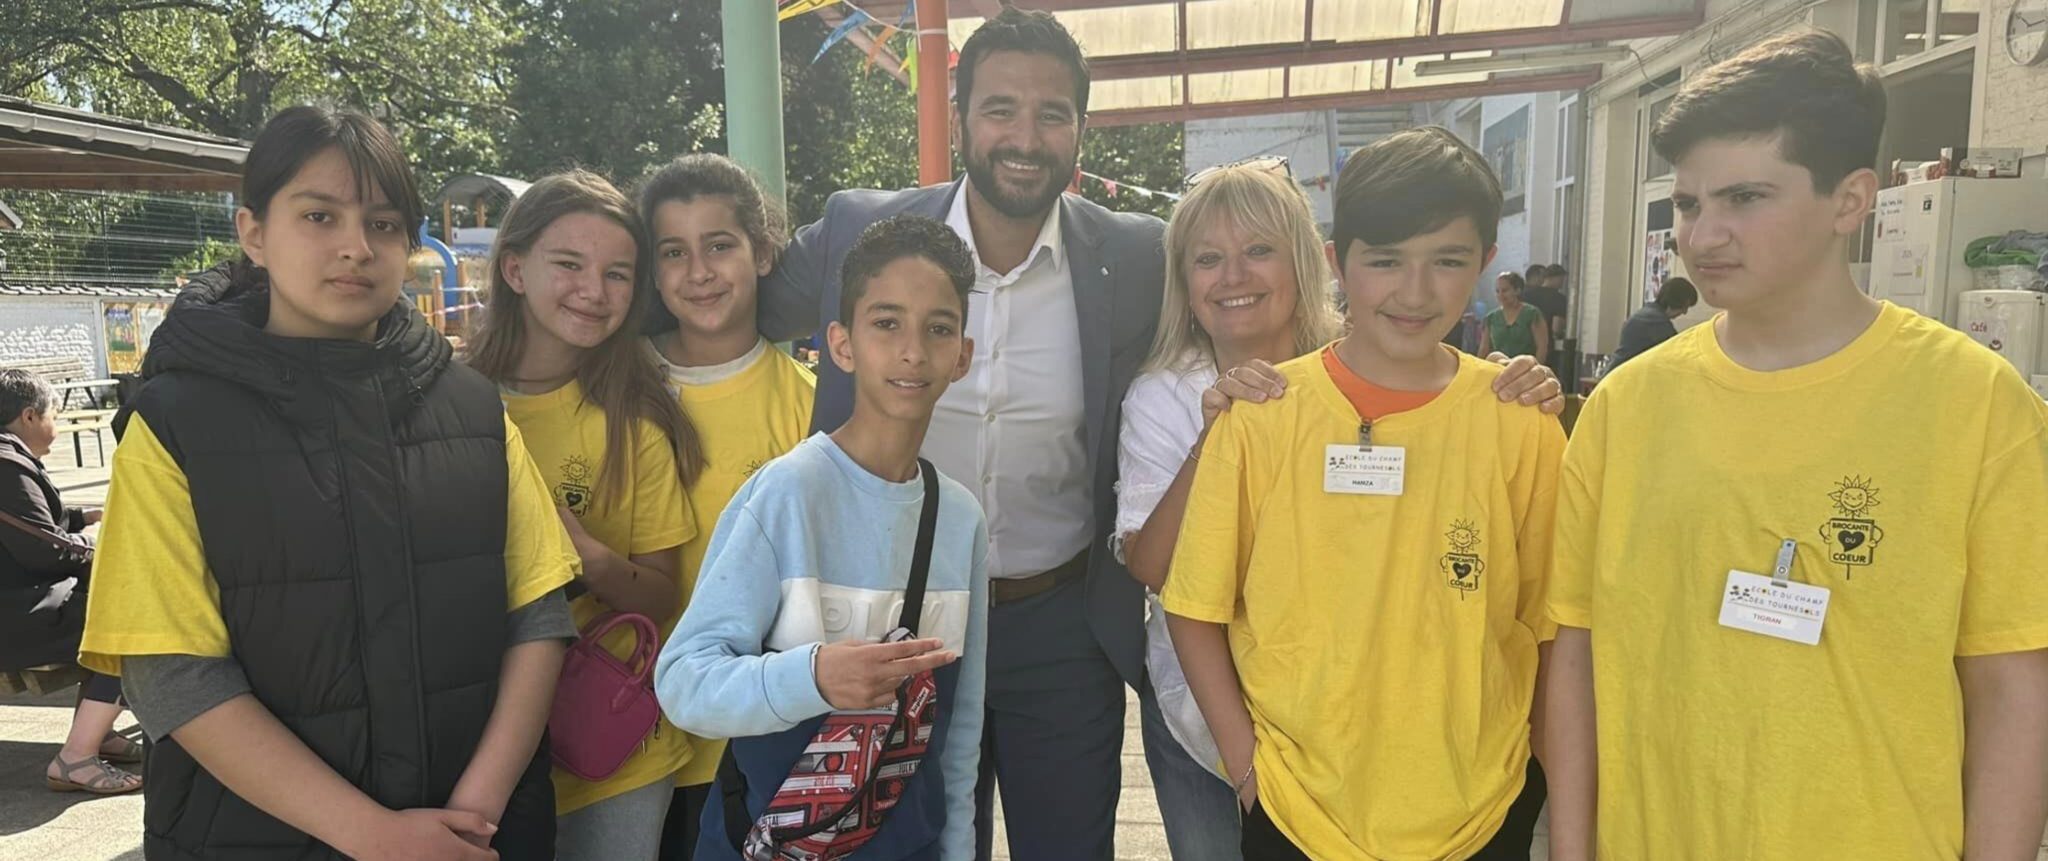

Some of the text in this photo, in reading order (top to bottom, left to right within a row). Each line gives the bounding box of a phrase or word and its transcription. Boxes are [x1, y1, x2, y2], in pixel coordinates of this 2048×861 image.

[1832, 522, 1869, 531] BROCANTE
[1448, 556, 1474, 564] BROCANTE
[1832, 552, 1866, 564] COEUR
[1450, 579, 1473, 588] COEUR
[1749, 596, 1820, 616] DES TOURNESOLS
[1794, 595, 1823, 606] CHAMP
[1753, 613, 1782, 624] TIGRAN
